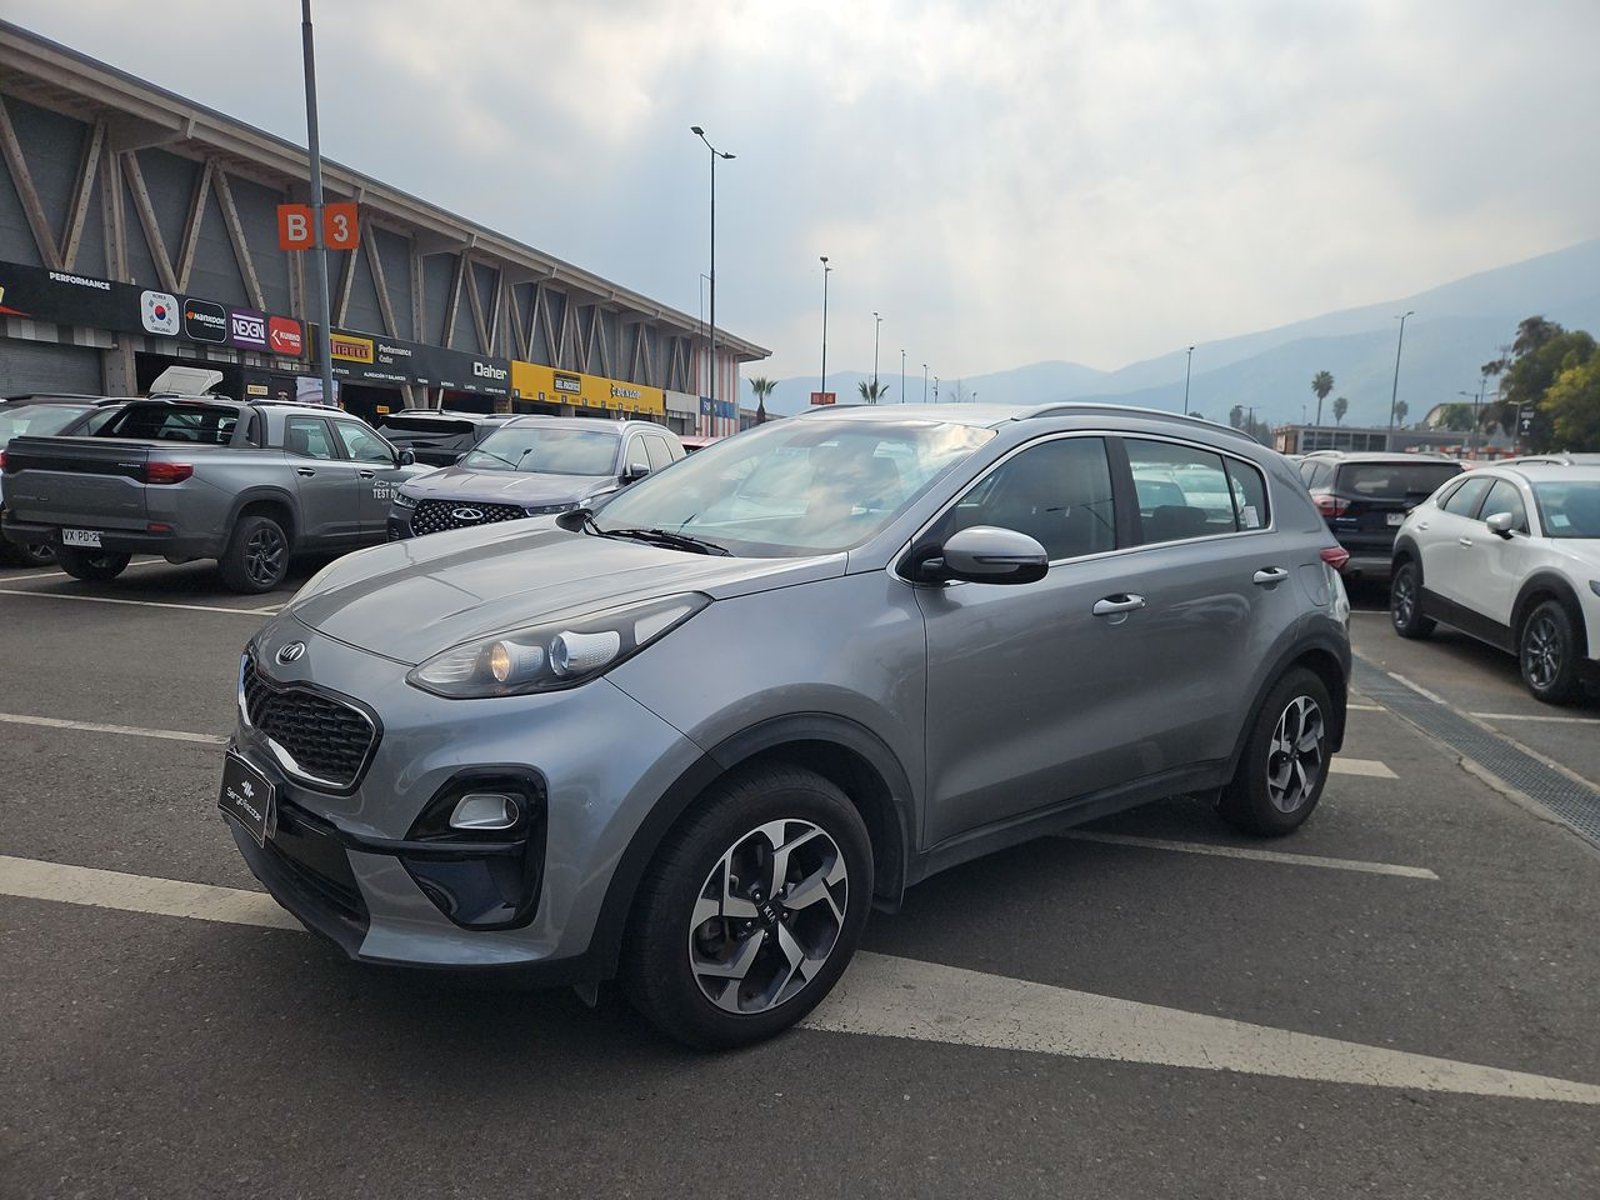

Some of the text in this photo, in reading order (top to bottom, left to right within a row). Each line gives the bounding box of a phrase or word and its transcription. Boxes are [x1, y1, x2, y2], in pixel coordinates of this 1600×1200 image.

[287, 214, 349, 242] B 3
[49, 271, 111, 291] PERFORMANCE
[473, 361, 507, 380] Daher
[373, 488, 390, 499] TEST
